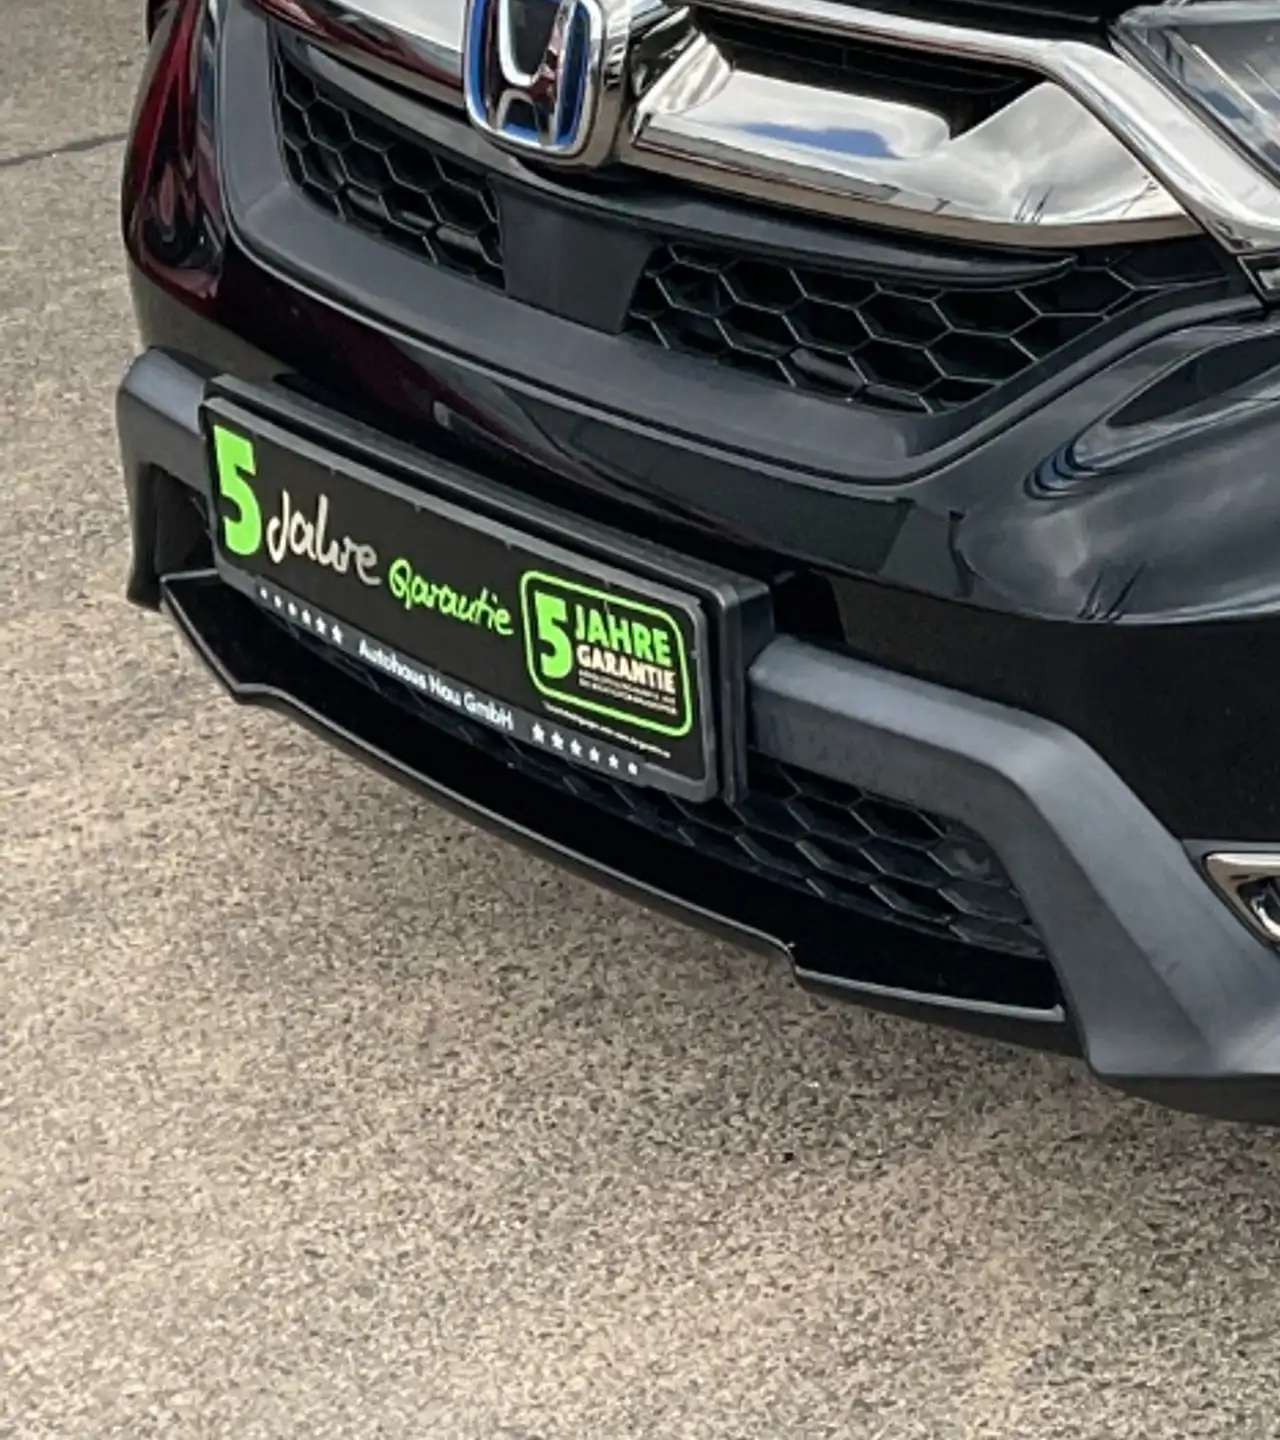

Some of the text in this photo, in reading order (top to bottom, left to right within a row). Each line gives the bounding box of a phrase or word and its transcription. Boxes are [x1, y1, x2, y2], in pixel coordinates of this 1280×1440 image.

[213, 424, 515, 636] 5 Jahre Garantie
[358, 638, 427, 691] Autohaus
[534, 590, 672, 679] 5 JAHRE
[576, 644, 677, 693] GARANTIE
